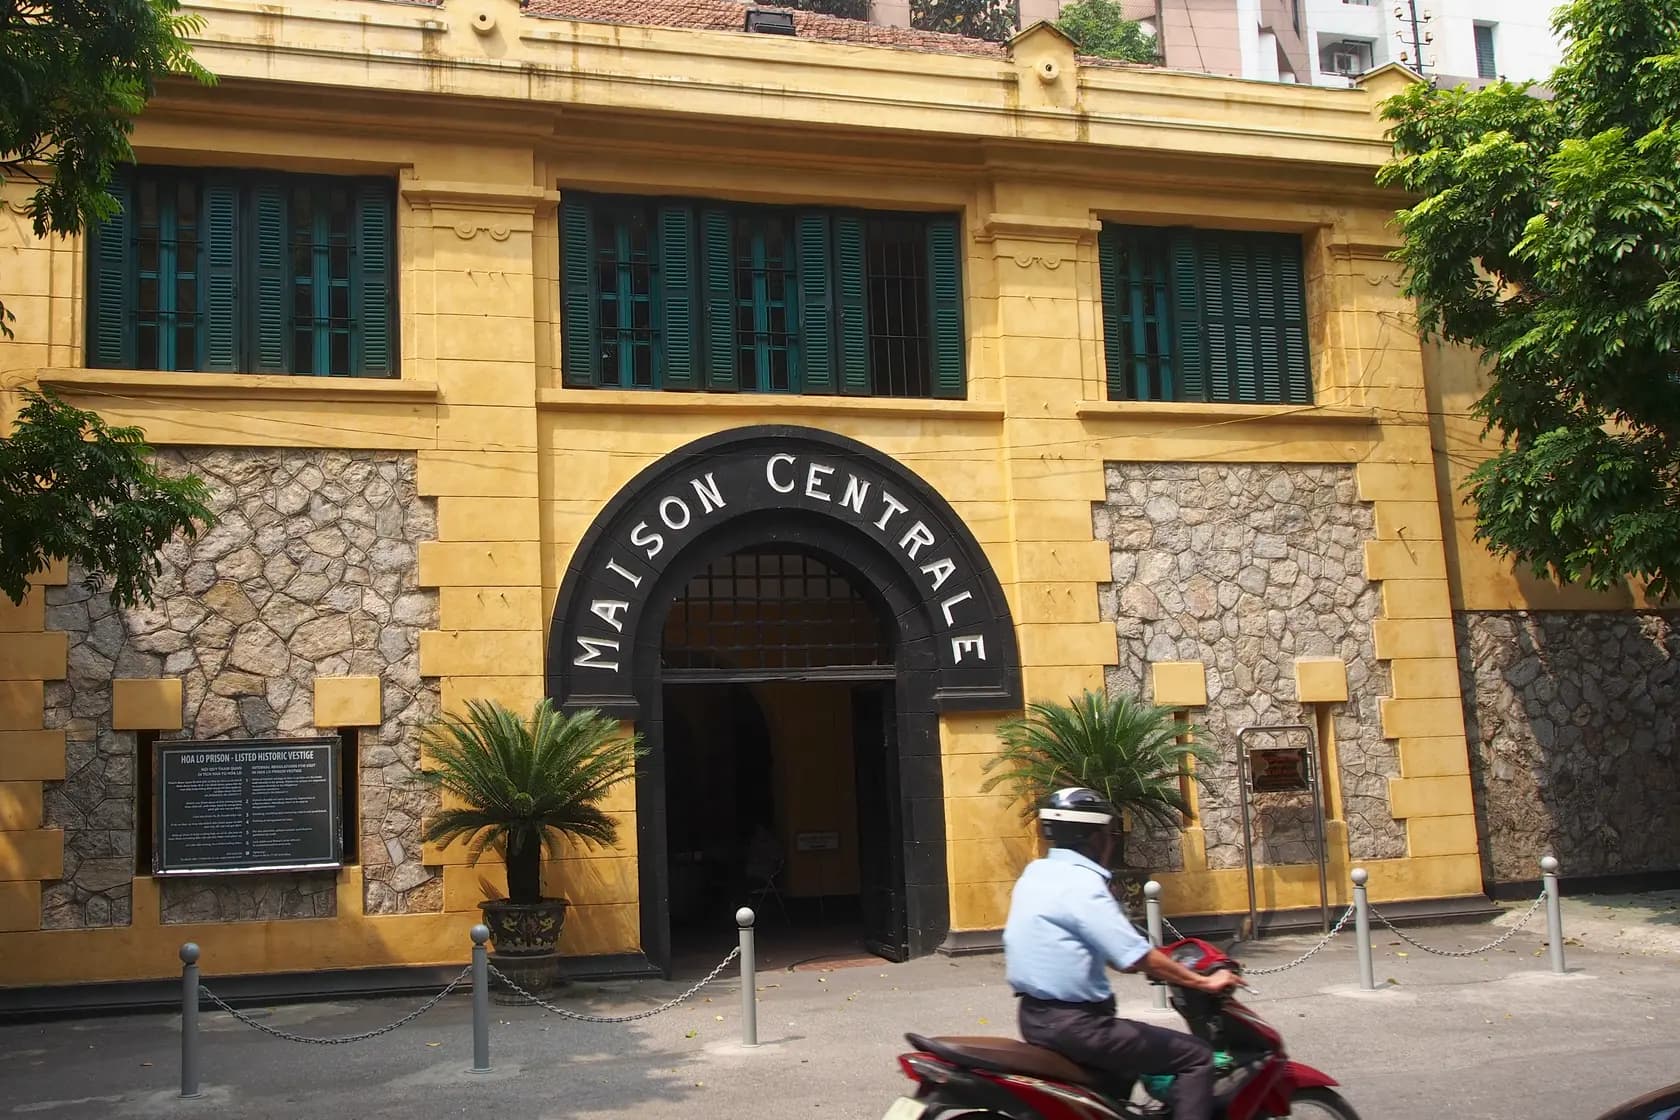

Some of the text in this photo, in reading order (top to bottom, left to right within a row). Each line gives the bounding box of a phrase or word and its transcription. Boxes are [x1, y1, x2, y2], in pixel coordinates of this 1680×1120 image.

[574, 453, 986, 673] MAISON CENTRALE
[181, 754, 195, 764] HOA
[196, 754, 205, 763] LO
[206, 753, 230, 763] PRISON
[235, 752, 257, 762] LISTED
[258, 751, 287, 761] HISTORIC
[288, 750, 314, 760] VESTIGE
